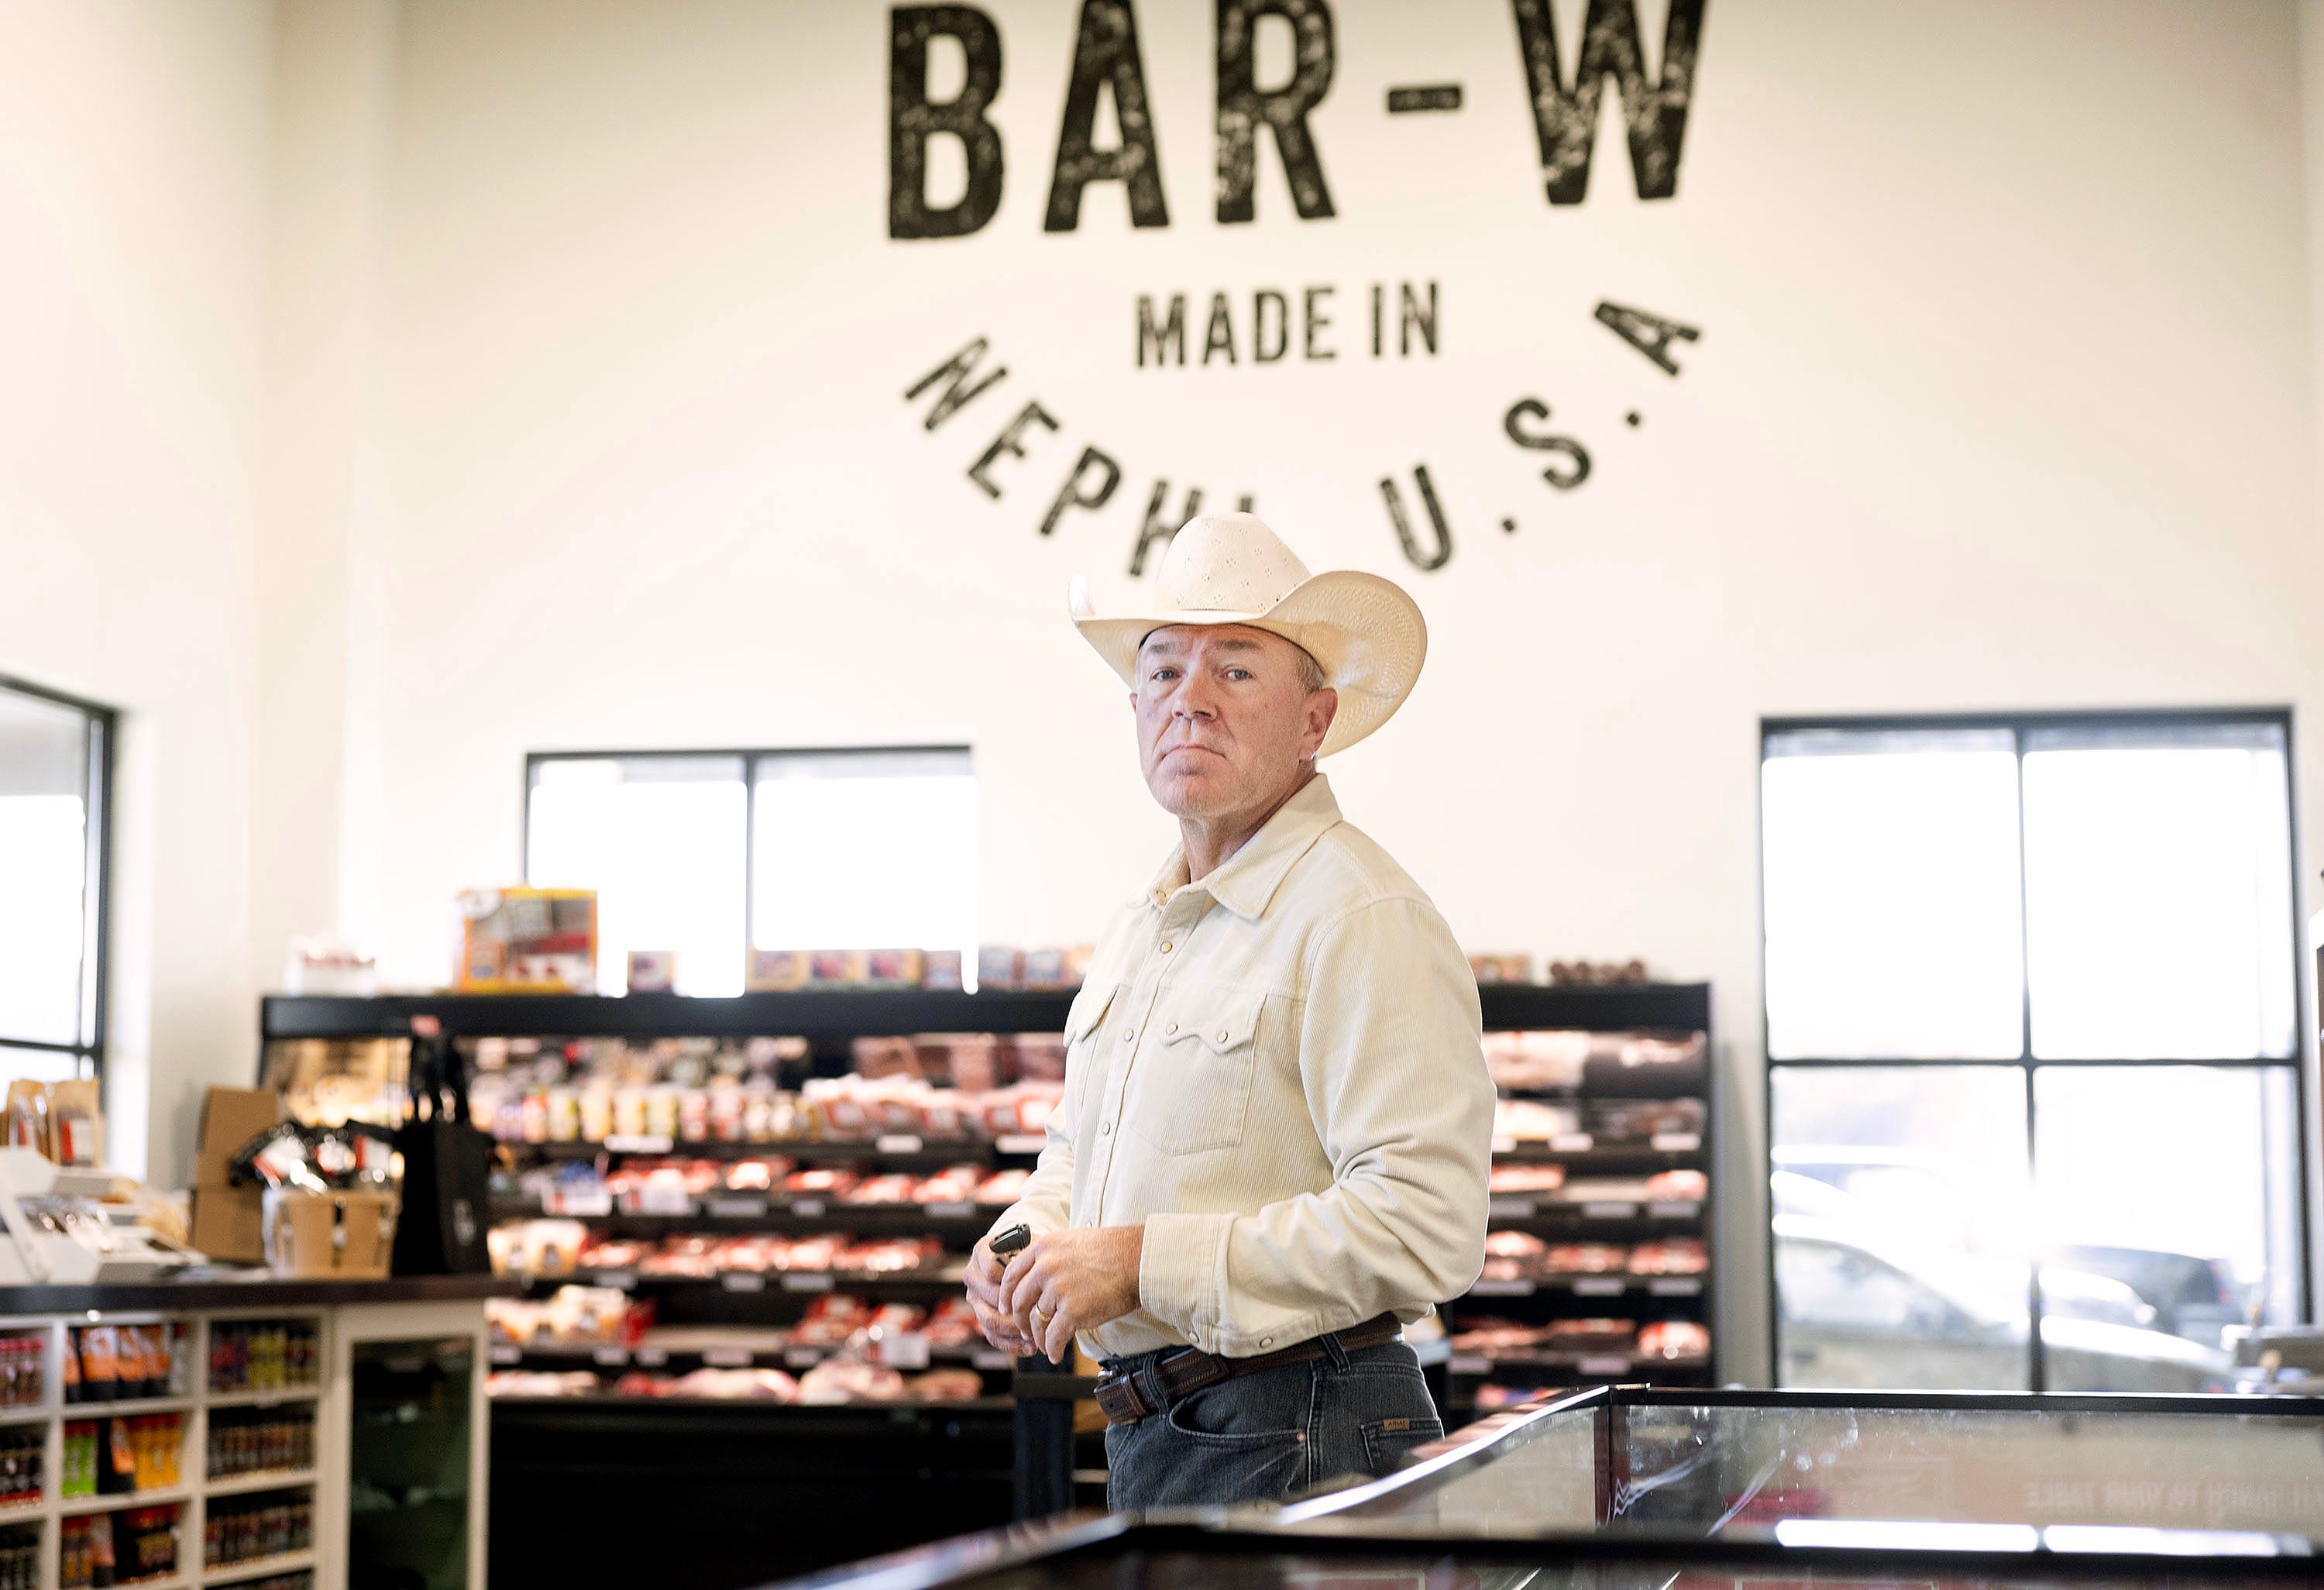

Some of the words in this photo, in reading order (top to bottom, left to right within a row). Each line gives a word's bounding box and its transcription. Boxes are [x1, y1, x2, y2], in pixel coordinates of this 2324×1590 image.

[889, 0, 1708, 239] BAR-W
[904, 336, 1253, 576] NEPH
[1379, 301, 1700, 571] U.S.A
[1137, 287, 1337, 367] MADE
[1370, 282, 1439, 356] IN
